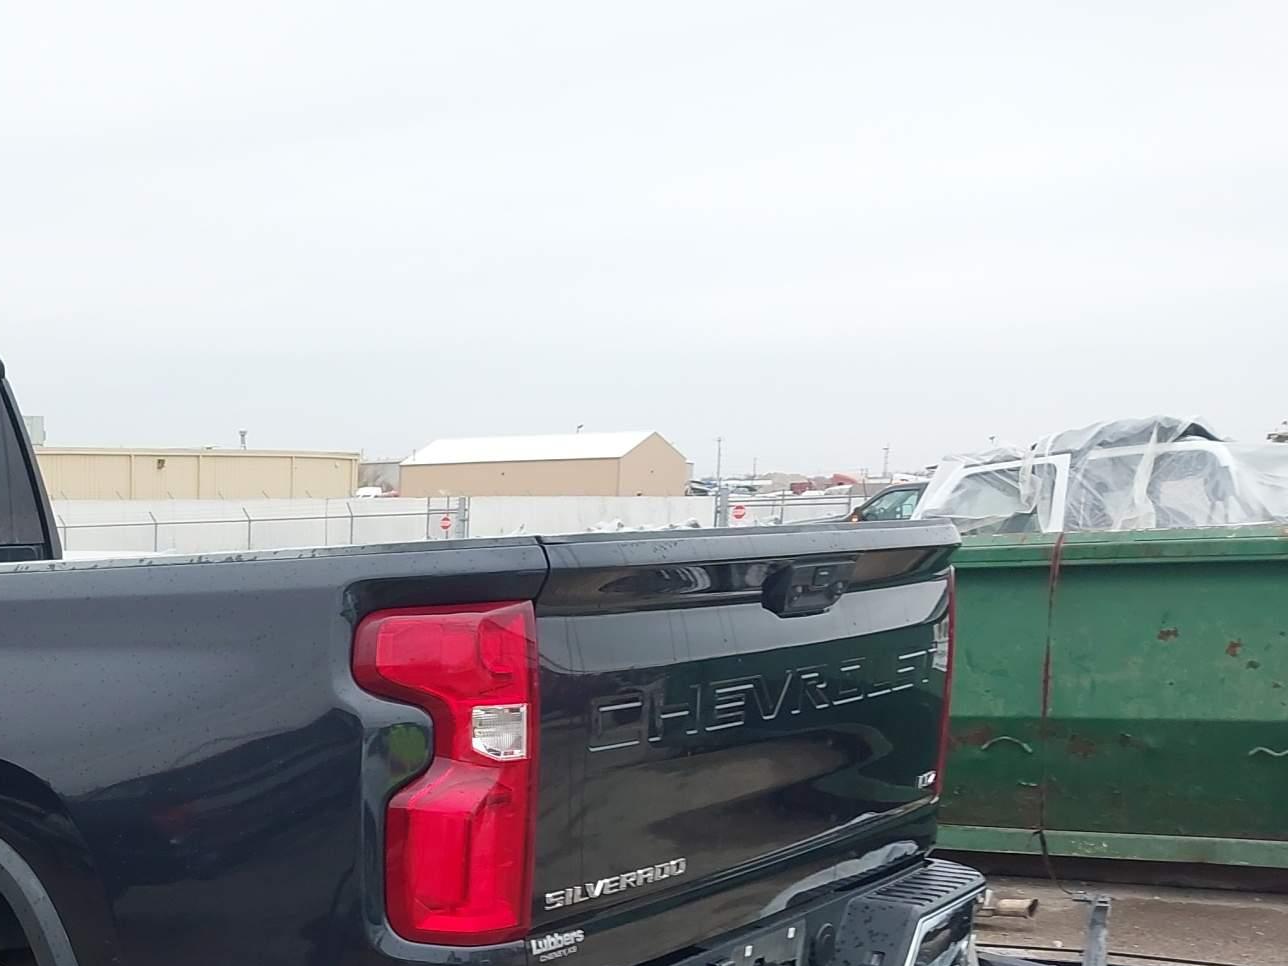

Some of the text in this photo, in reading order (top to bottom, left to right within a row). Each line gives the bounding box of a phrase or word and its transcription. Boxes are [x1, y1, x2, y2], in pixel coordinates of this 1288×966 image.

[588, 645, 938, 752] CHEVROLET
[544, 857, 687, 911] SILVERADO
[530, 929, 585, 955] Lubbers
